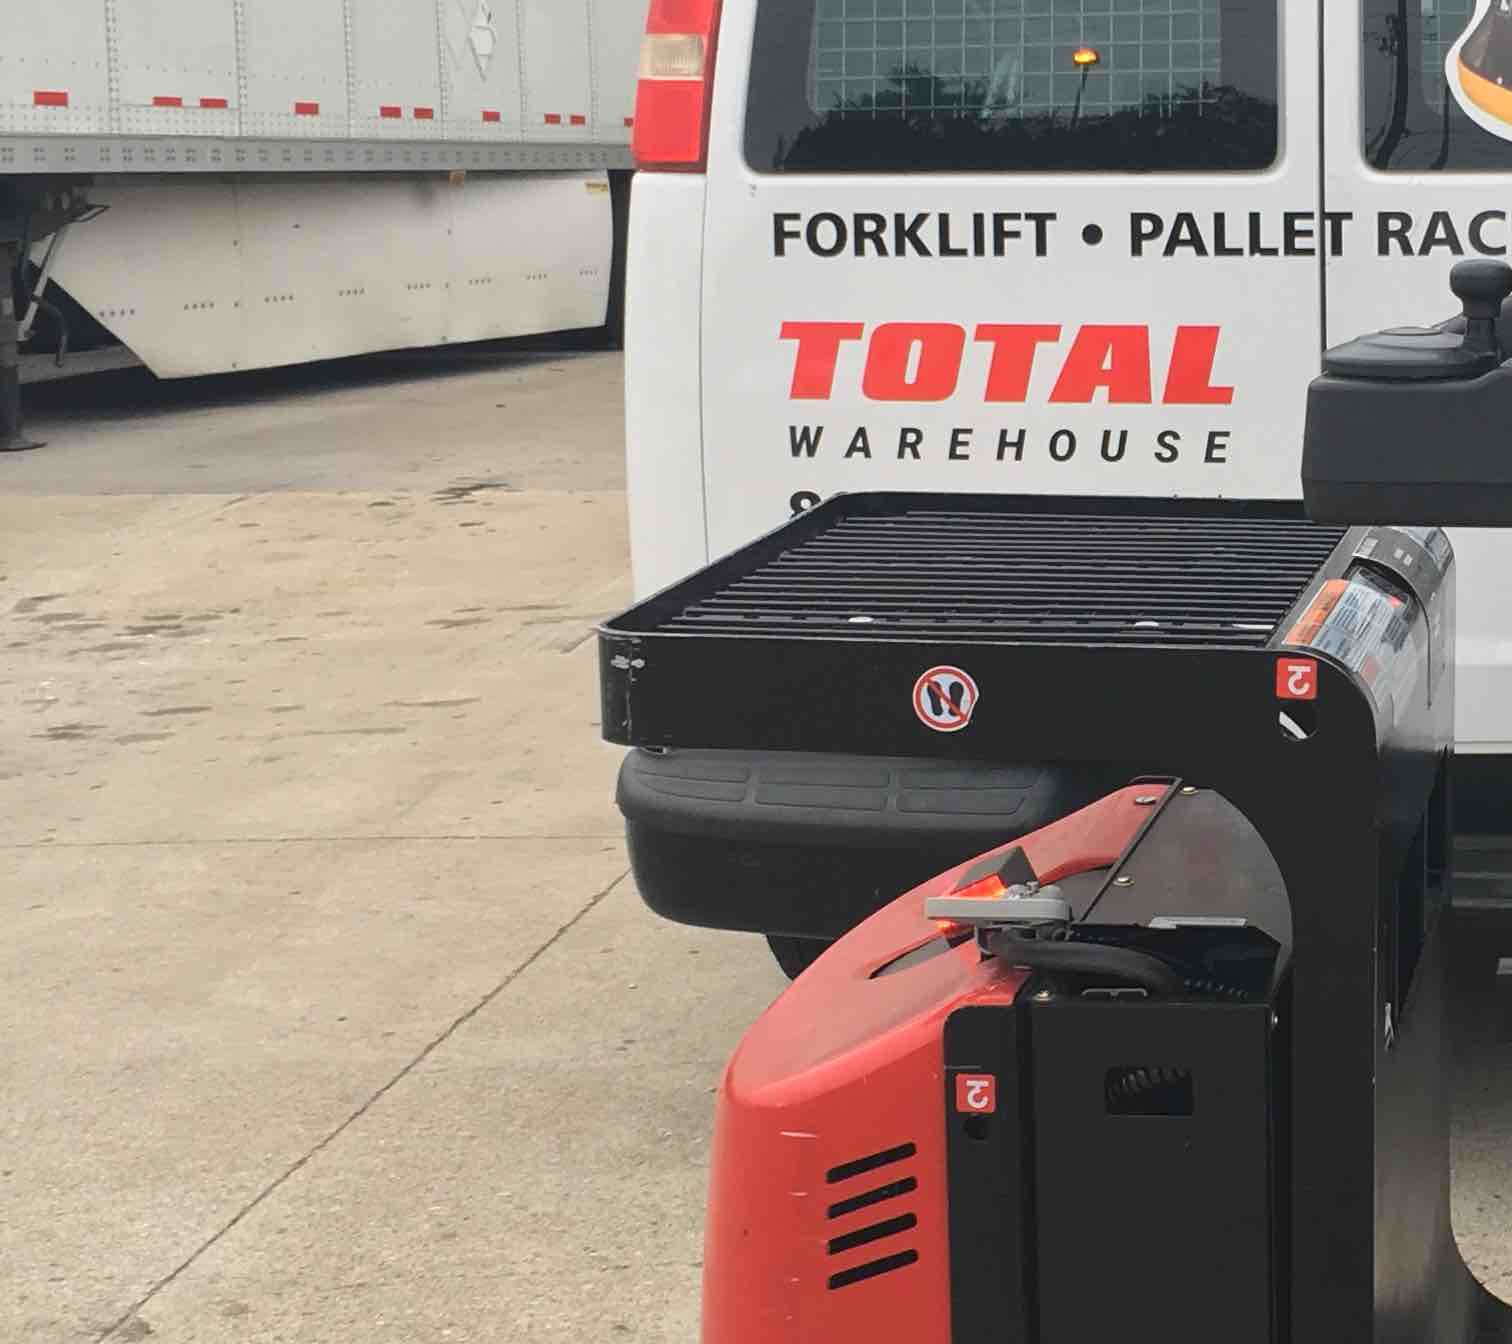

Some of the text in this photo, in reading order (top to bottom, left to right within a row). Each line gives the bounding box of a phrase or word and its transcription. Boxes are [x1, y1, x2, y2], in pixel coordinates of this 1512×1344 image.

[772, 211, 1057, 257] FORKLIFT
[1130, 211, 1352, 257] PALLET
[779, 321, 1235, 405] TOTAL
[788, 425, 1231, 464] WAREHOUSE
